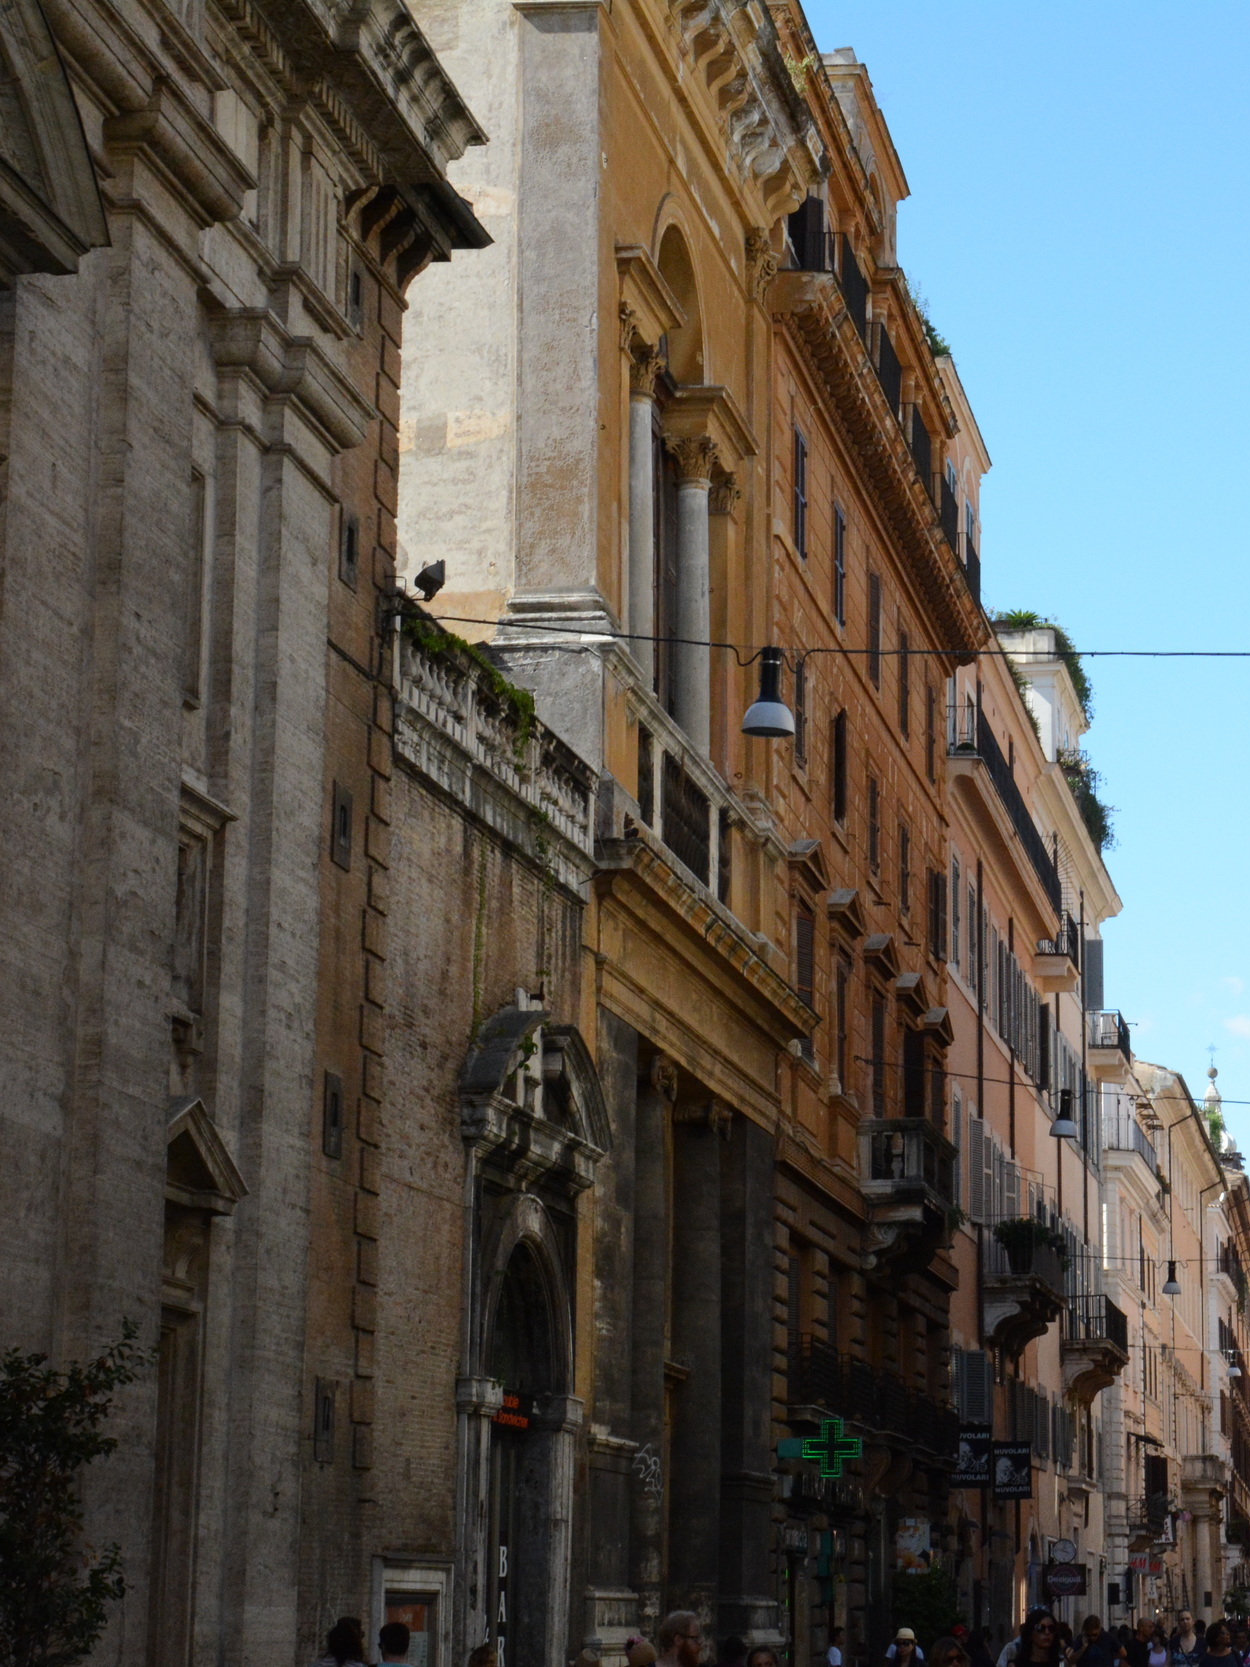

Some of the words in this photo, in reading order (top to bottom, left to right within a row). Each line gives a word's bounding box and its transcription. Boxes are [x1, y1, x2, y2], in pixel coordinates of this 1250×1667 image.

[959, 1432, 990, 1440] VOLARI
[995, 1485, 1031, 1493] NUVOLARI
[497, 1545, 508, 1667] BAR
